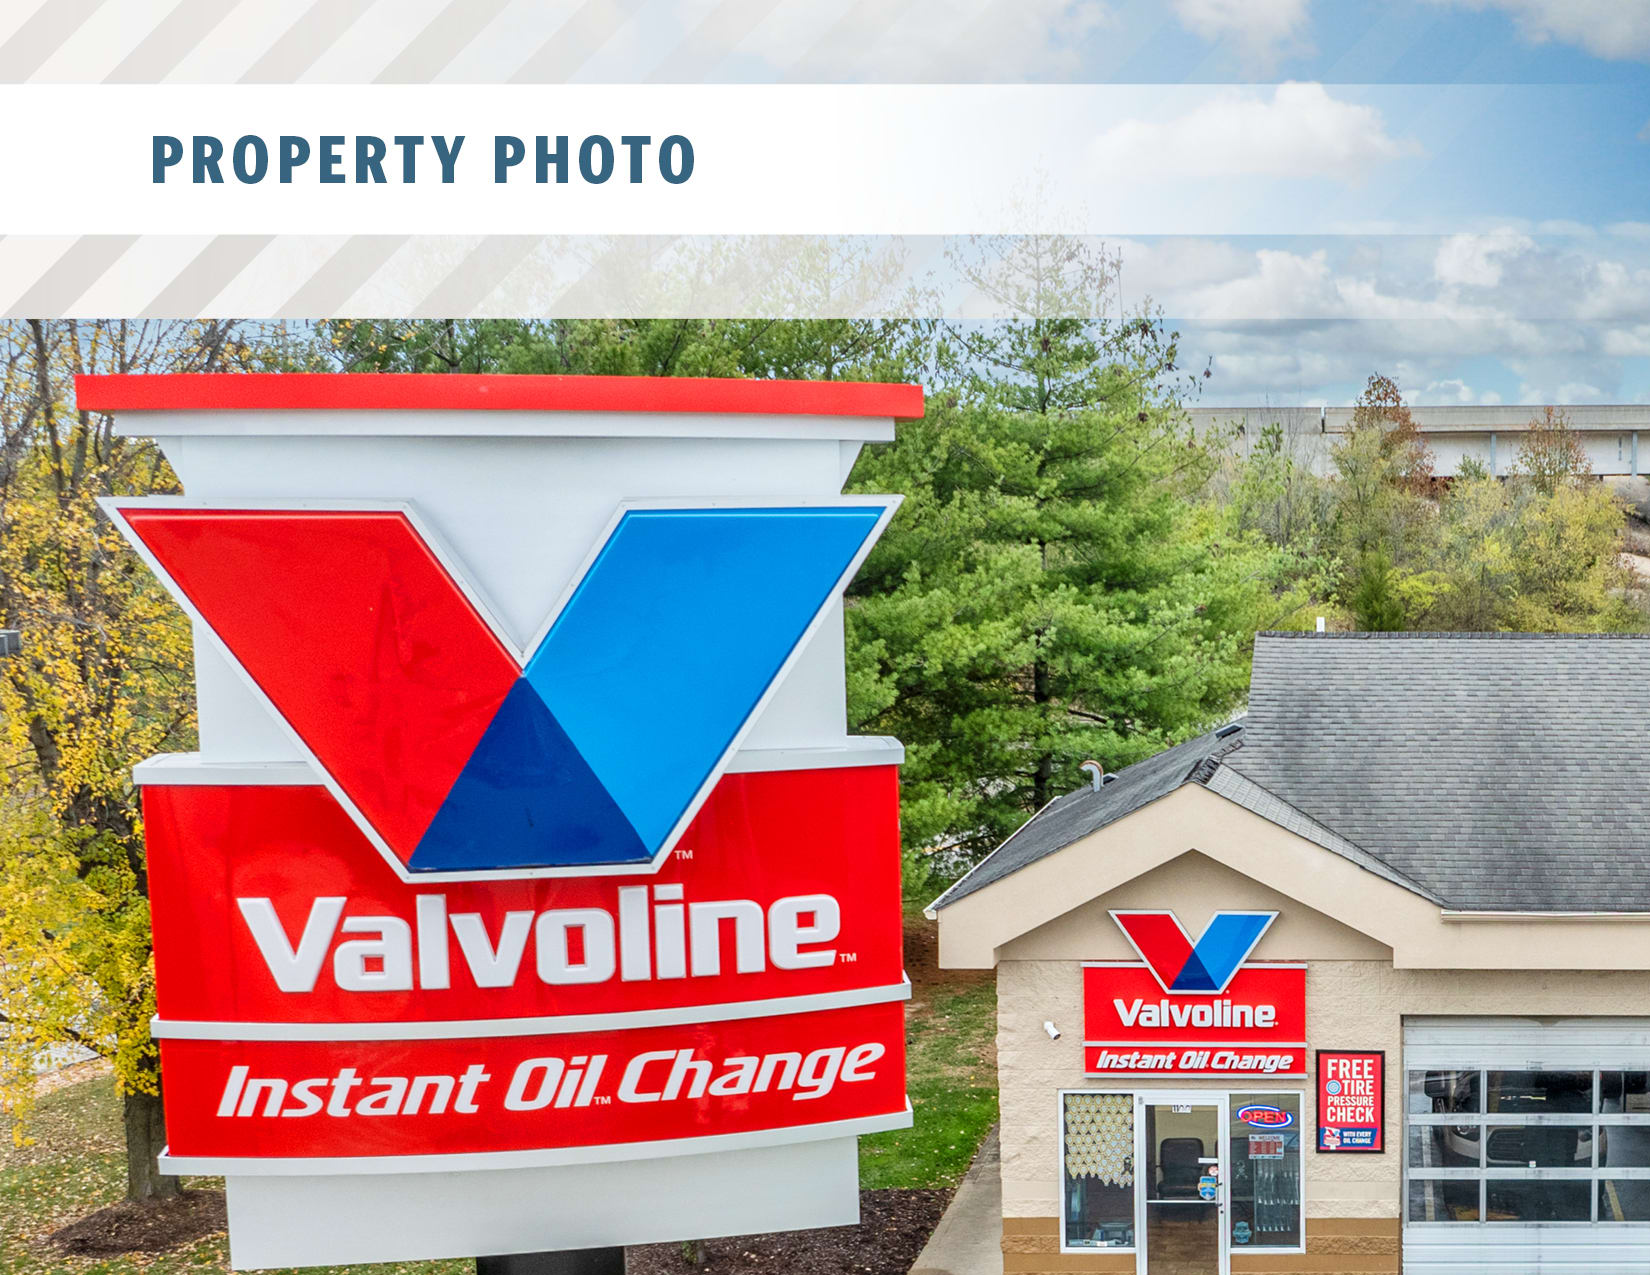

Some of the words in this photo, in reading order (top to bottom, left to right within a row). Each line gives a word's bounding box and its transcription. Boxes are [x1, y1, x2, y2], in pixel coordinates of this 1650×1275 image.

[236, 882, 842, 993] Valvoline
[1113, 998, 1276, 1028] Valvoline
[1096, 1050, 1177, 1070] Instant
[1178, 1050, 1211, 1070] Oil
[1211, 1051, 1295, 1073] Change
[1327, 1058, 1375, 1079] FREE
[215, 1064, 492, 1118] Instant
[503, 1054, 609, 1113] Oil
[616, 1041, 886, 1104] Change
[1342, 1079, 1375, 1096] TIRE
[1327, 1095, 1375, 1106] PRESSURE
[1240, 1110, 1287, 1124] OPEN
[1326, 1106, 1375, 1123] CHECK
